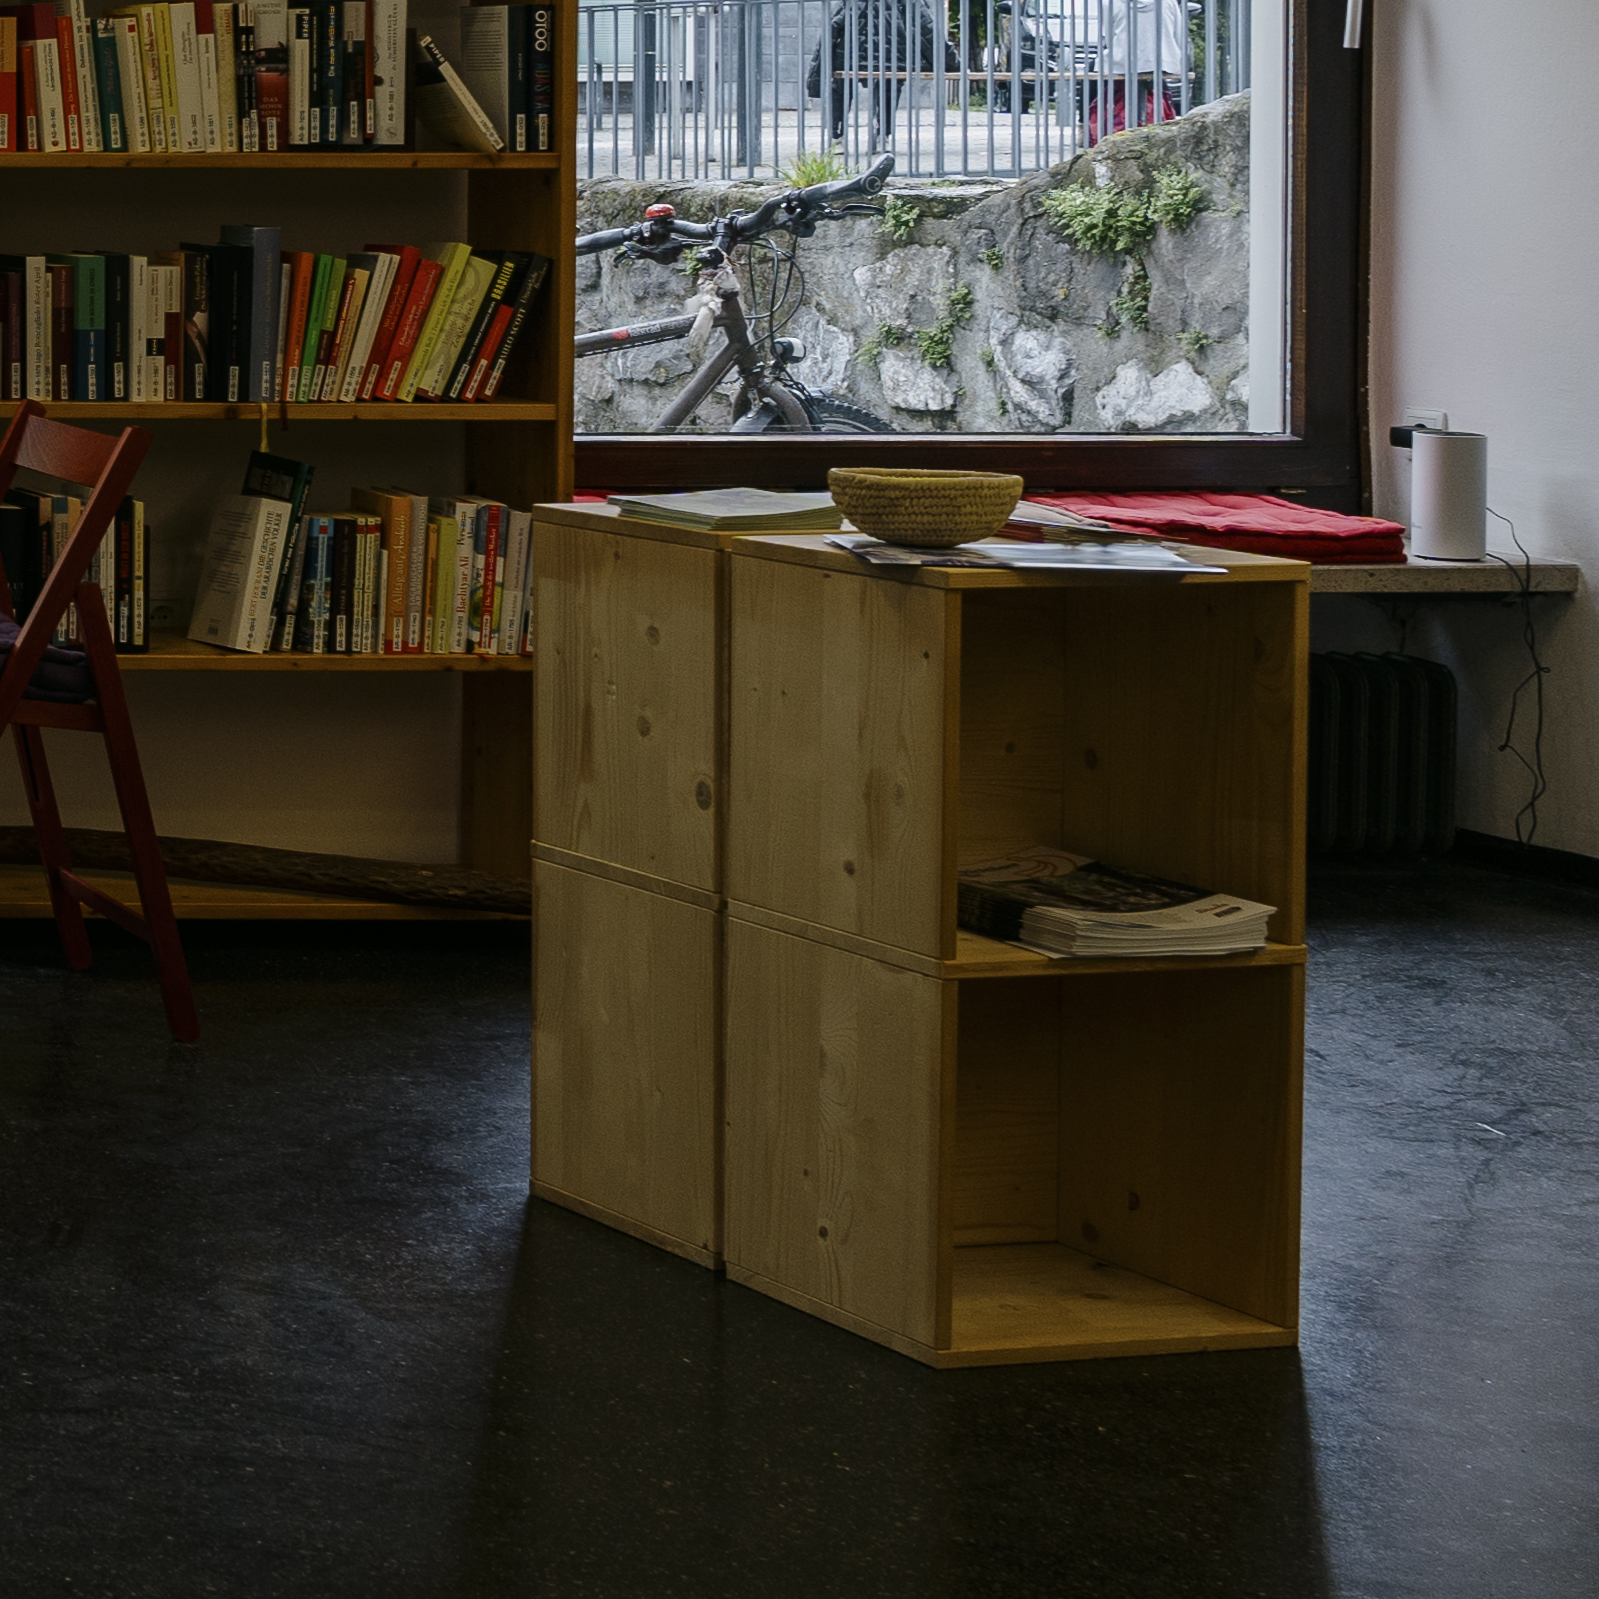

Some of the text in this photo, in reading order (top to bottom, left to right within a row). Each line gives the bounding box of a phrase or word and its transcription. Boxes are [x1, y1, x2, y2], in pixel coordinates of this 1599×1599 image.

[490, 261, 515, 300] BRASILIEN
[451, 335, 463, 348] Zeit
[510, 307, 526, 335] SCOTT
[252, 510, 274, 599] HOURANI DIE GESCHICHTE
[262, 541, 277, 584] ARABISCHEN
[392, 515, 406, 605] Alltag auf Arabisch
[260, 585, 268, 599] DER
[456, 556, 469, 613] Bachtyar Ali
